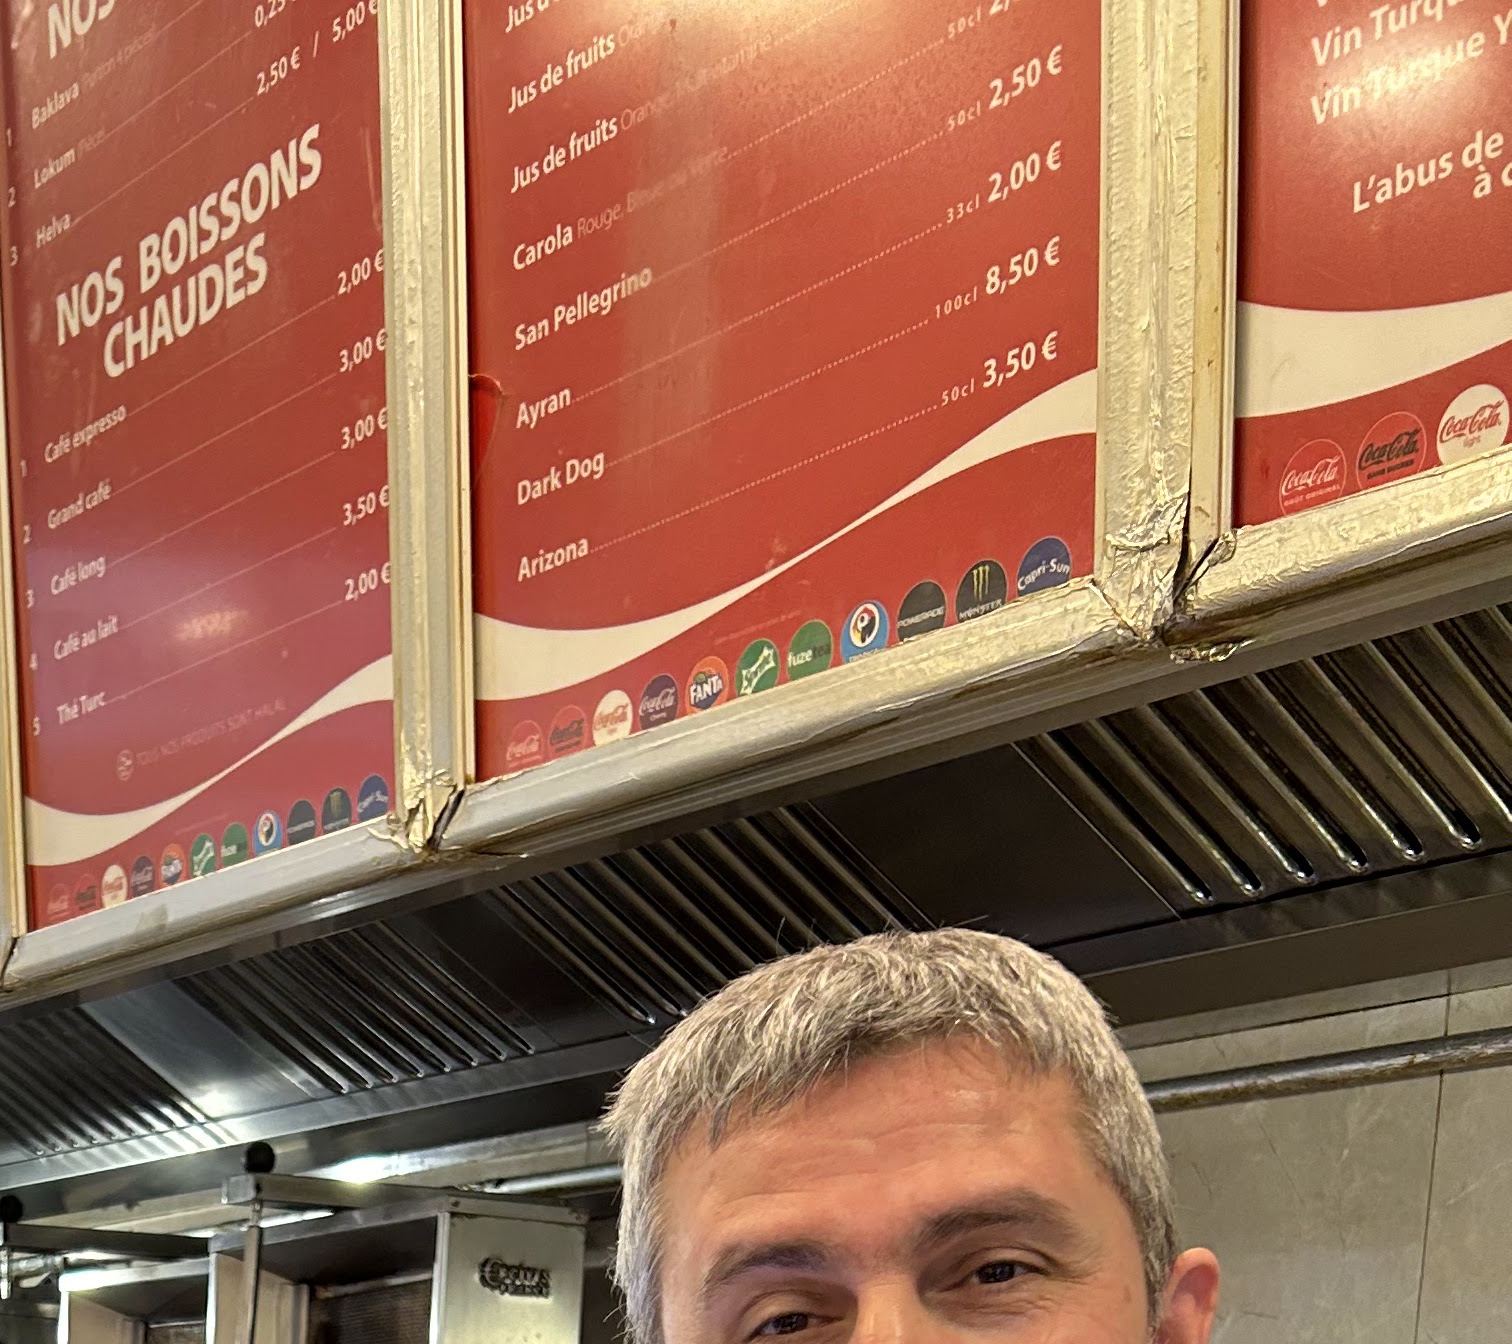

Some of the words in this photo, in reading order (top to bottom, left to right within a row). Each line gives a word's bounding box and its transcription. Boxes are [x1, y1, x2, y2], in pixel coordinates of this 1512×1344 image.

[31, 82, 79, 130] Baklava
[508, 79, 537, 114] Jus
[540, 63, 564, 93] de
[566, 33, 616, 78] fruits
[1310, 83, 1362, 125] Vin
[1311, 25, 1362, 67] Vin
[1369, 0, 1464, 41] Turq
[7, 186, 16, 208] 2
[33, 147, 76, 189] Lokum
[9, 245, 18, 267] 3
[36, 213, 72, 249] Helva
[256, 55, 288, 96] 2,50
[290, 45, 301, 70] €
[332, 1, 365, 43] 5,00
[511, 166, 540, 194] Jus
[542, 145, 566, 175] de
[569, 117, 618, 160] fruits
[512, 223, 573, 271] Carola
[947, 6, 982, 39] 50cl
[515, 317, 550, 351] San
[553, 267, 653, 332] Pellegrino
[946, 101, 982, 132] 50cl
[988, 57, 1041, 110] 2,50
[1046, 44, 1063, 75] €
[1352, 151, 1453, 213] L'abus
[1461, 130, 1505, 169] de
[1472, 164, 1492, 199] à
[56, 256, 125, 347] NOS
[139, 123, 322, 294] BOISSONS
[103, 231, 268, 378] CHAUDES
[516, 388, 572, 429] Ayran
[946, 192, 981, 224] 33cl
[988, 152, 1040, 203] 2,00
[1045, 139, 1062, 171] €
[44, 431, 72, 463] Café
[72, 404, 127, 448] expresso
[337, 256, 371, 295] 2,00
[47, 491, 85, 529] Grand
[85, 477, 112, 509] café
[339, 336, 373, 373] 3,00
[517, 465, 563, 506] Dark
[565, 452, 606, 485] Dog
[935, 285, 978, 319] 100cl
[985, 247, 1038, 295] 8,50
[1044, 235, 1061, 267] €
[26, 589, 35, 609] 3
[50, 565, 78, 595] Café
[77, 555, 106, 581] long
[341, 413, 375, 450] 3,00
[517, 537, 590, 583] Arizona
[940, 377, 975, 407] 50cl
[983, 341, 1036, 388] 3,50
[1041, 330, 1058, 361] €
[32, 714, 41, 737] 5
[56, 700, 79, 725] Thé
[344, 567, 378, 602] 2,00
[54, 631, 81, 660] Café
[80, 628, 98, 648] au
[97, 614, 119, 640] lait
[342, 491, 377, 527] 3,50
[1017, 557, 1072, 592] Capri-Sun
[689, 674, 724, 705] FANTA
